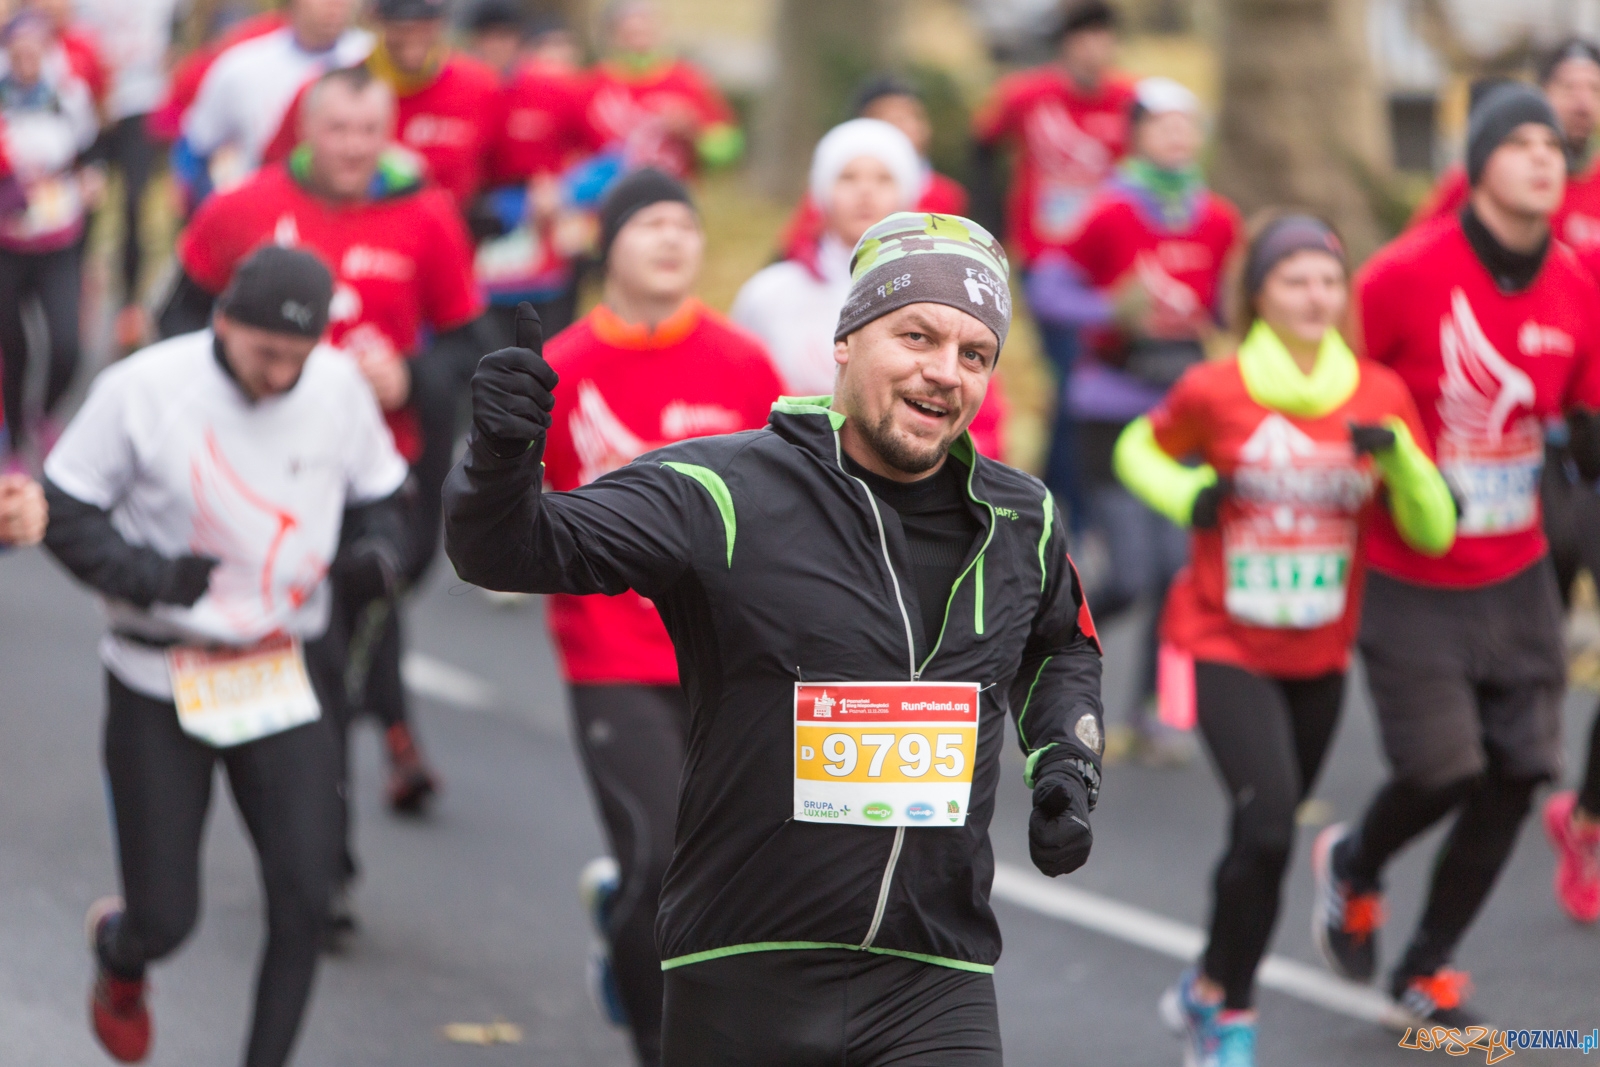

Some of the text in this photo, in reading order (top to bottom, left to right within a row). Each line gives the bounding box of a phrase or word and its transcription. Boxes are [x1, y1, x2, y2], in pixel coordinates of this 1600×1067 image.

[839, 698, 848, 714] 1
[901, 701, 970, 713] RunPoland.org
[801, 733, 965, 778] D 9795
[804, 800, 834, 810] GRUPA
[804, 808, 839, 819] LUXMED
[866, 808, 891, 817] energy
